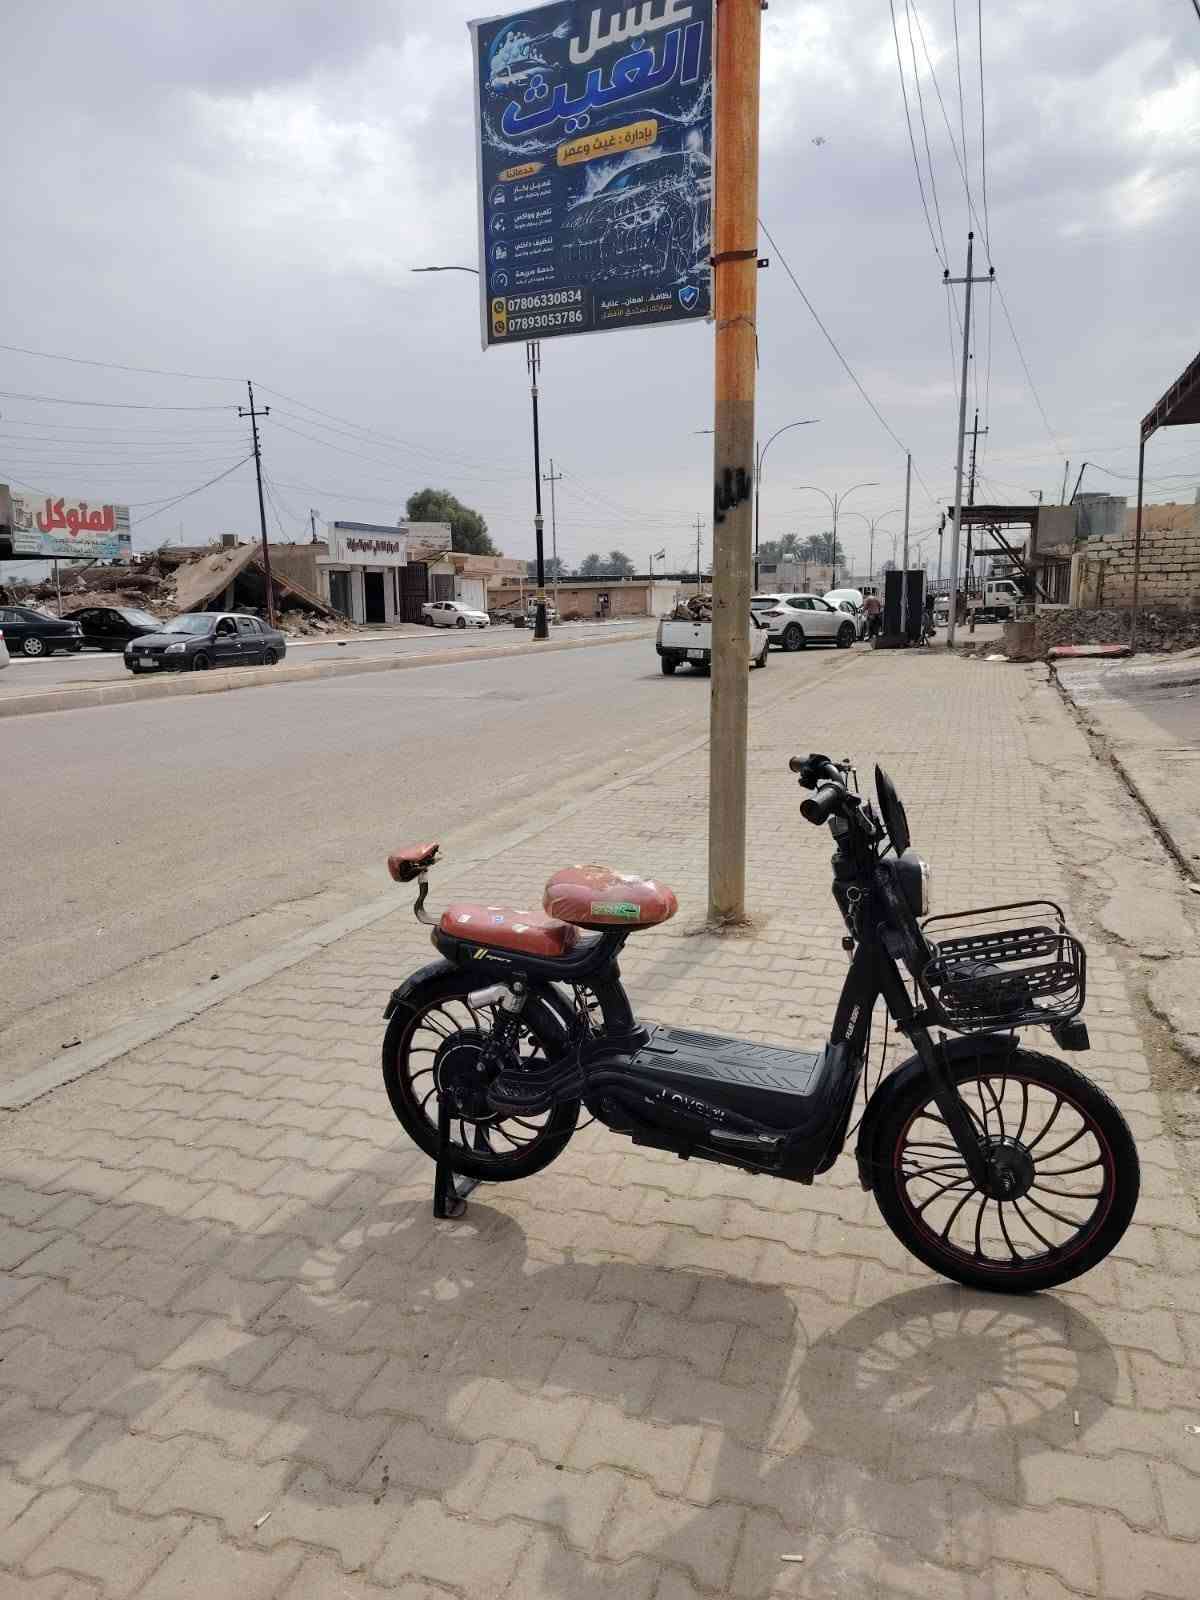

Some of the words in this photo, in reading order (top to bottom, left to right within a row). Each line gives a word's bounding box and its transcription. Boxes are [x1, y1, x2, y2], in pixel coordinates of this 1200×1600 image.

[502, 21, 704, 137] الغيث
[562, 144, 591, 161] وعمر
[593, 134, 617, 151] غيث
[508, 289, 582, 311] 07806330834
[508, 310, 583, 331] 07893053786
[36, 497, 114, 537] المتوكل
